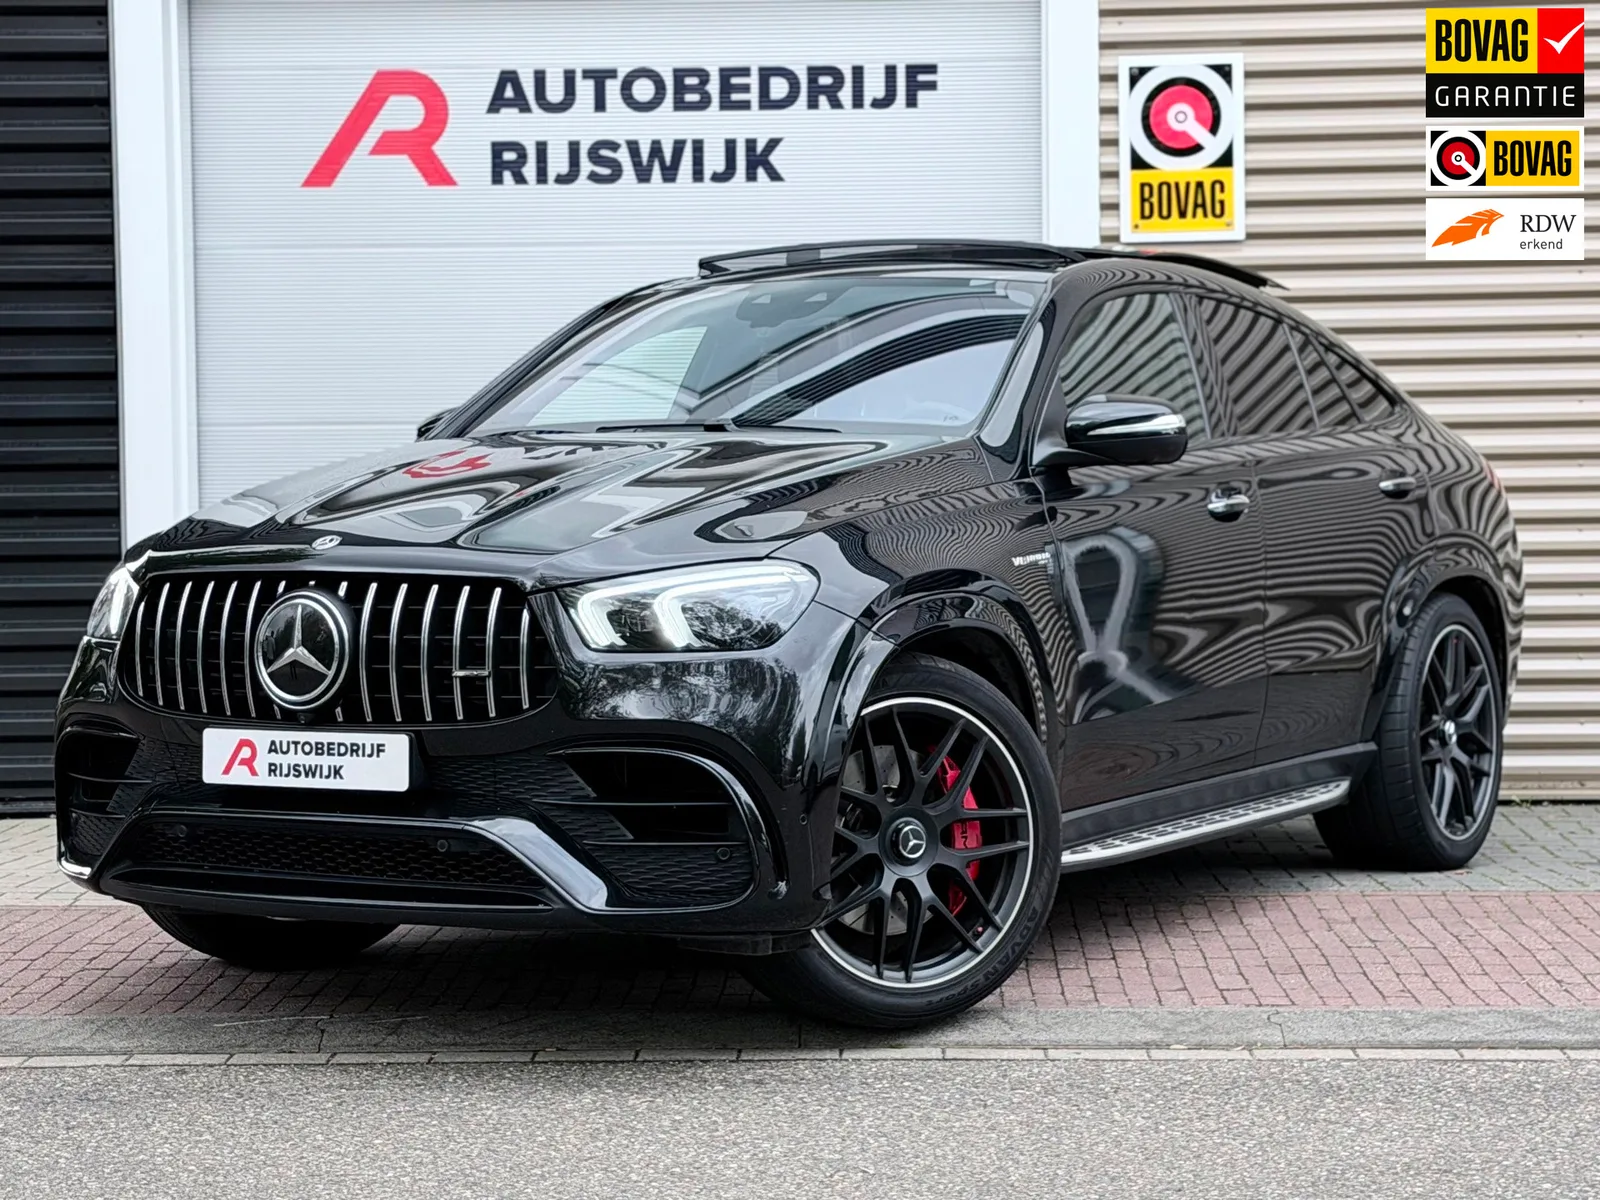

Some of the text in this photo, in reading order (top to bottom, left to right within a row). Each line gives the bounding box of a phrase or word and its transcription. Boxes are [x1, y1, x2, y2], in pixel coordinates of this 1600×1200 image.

[487, 64, 938, 113] AUTOBEDRIJF
[491, 138, 784, 185] RIJSWIJK
[1139, 179, 1225, 220] BOVAG
[267, 740, 386, 758] AUTOBEDRIJF
[268, 763, 344, 779] RIJSWIJK
